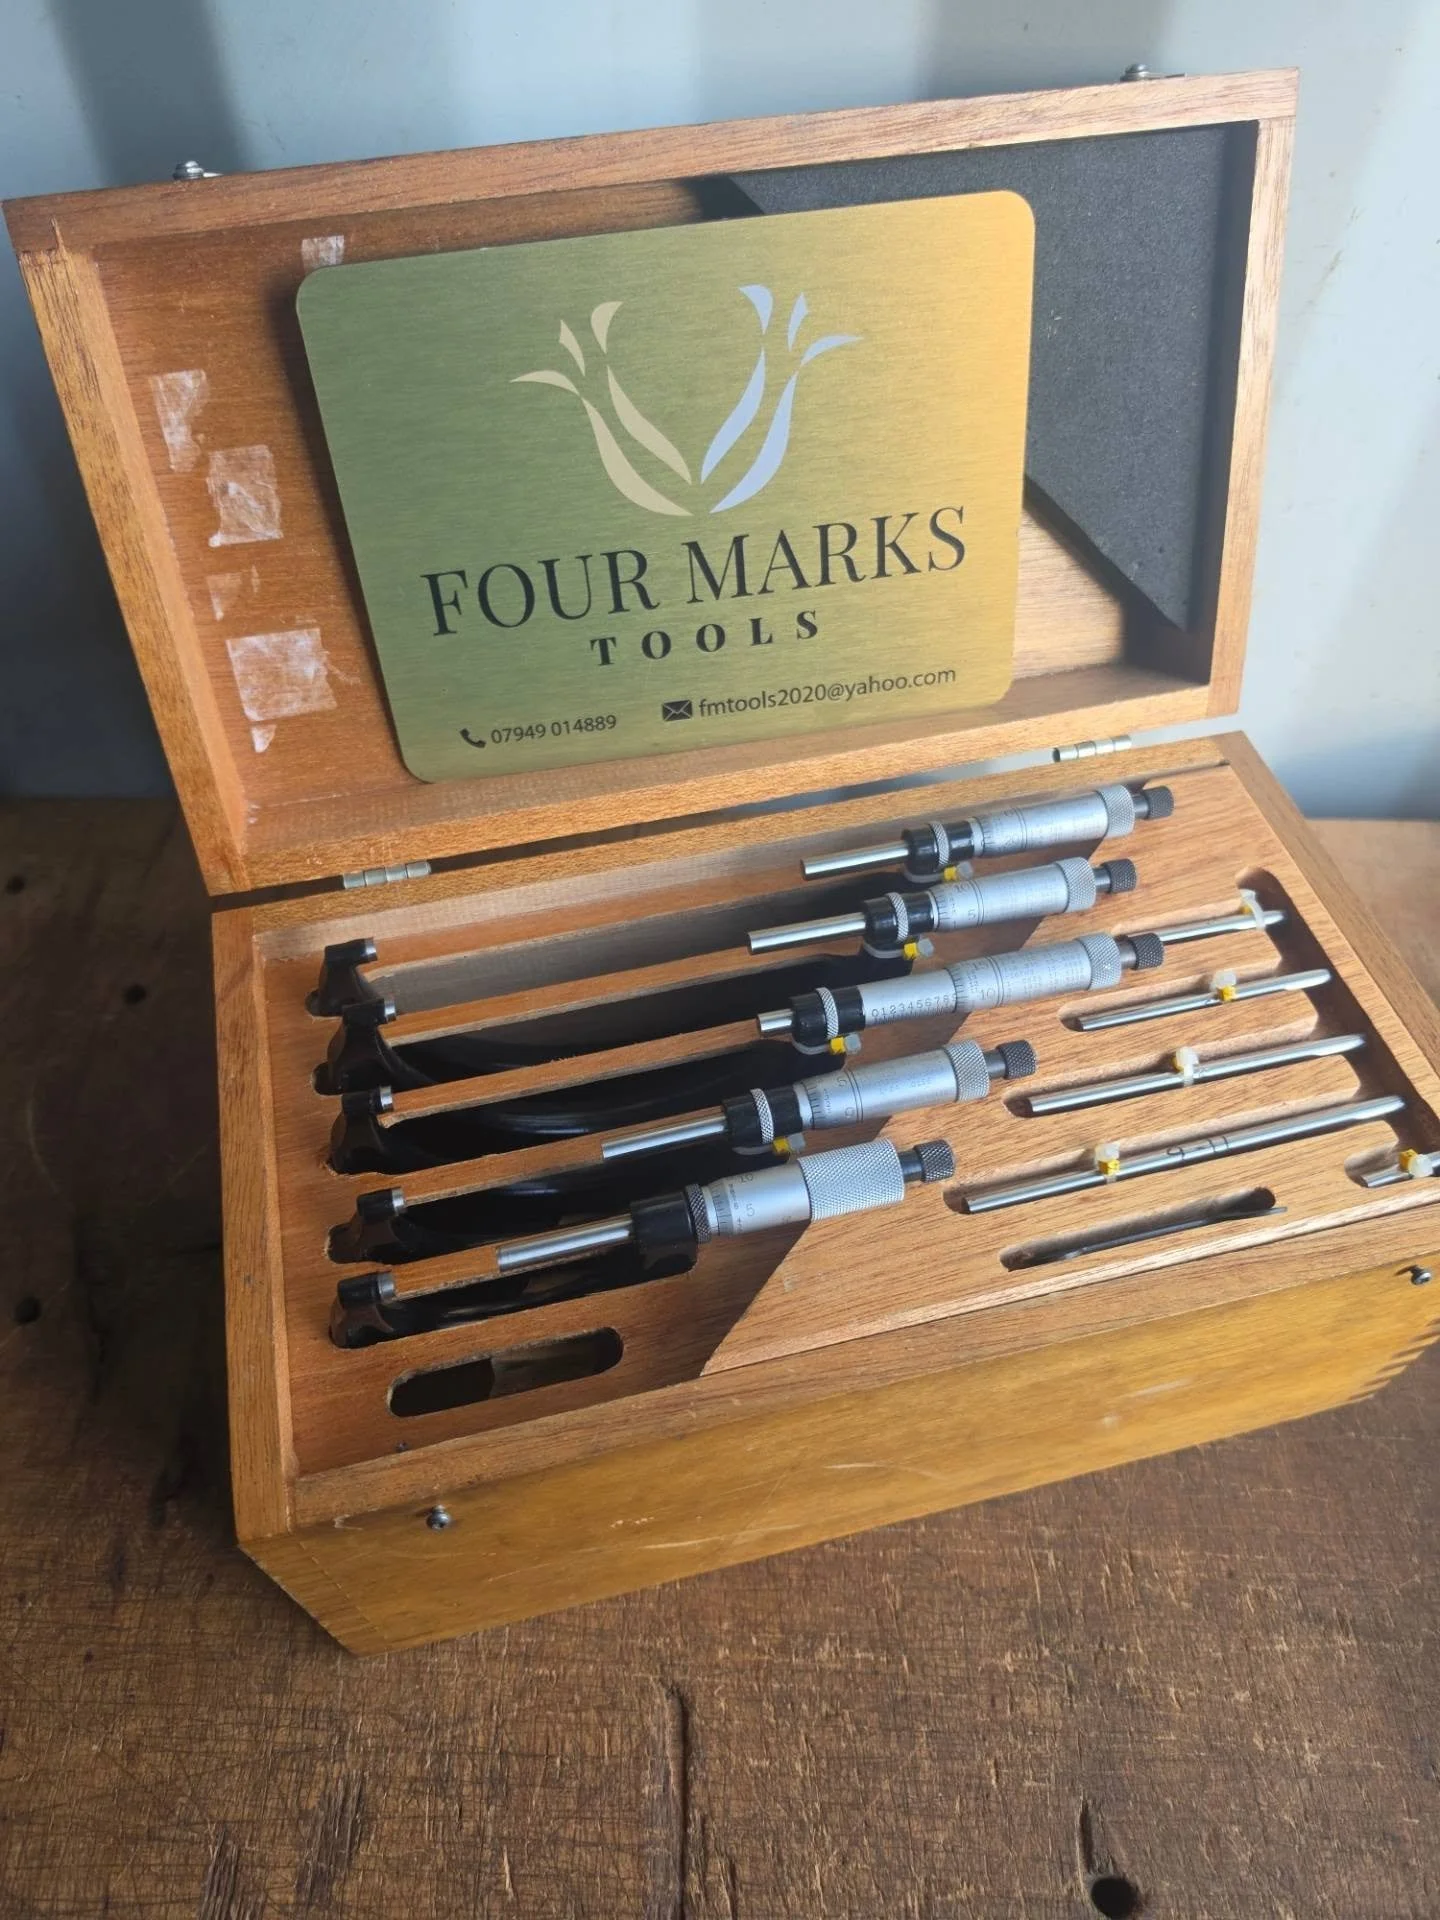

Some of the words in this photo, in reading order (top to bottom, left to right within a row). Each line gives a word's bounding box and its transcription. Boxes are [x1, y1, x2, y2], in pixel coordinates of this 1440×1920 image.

[419, 548, 661, 637] FOUR
[681, 505, 967, 604] MARKS
[590, 609, 819, 667] TOOLS
[698, 667, 957, 718] fmtools2020@yahoo.com
[490, 723, 547, 745] 07949
[551, 714, 618, 737] 014889
